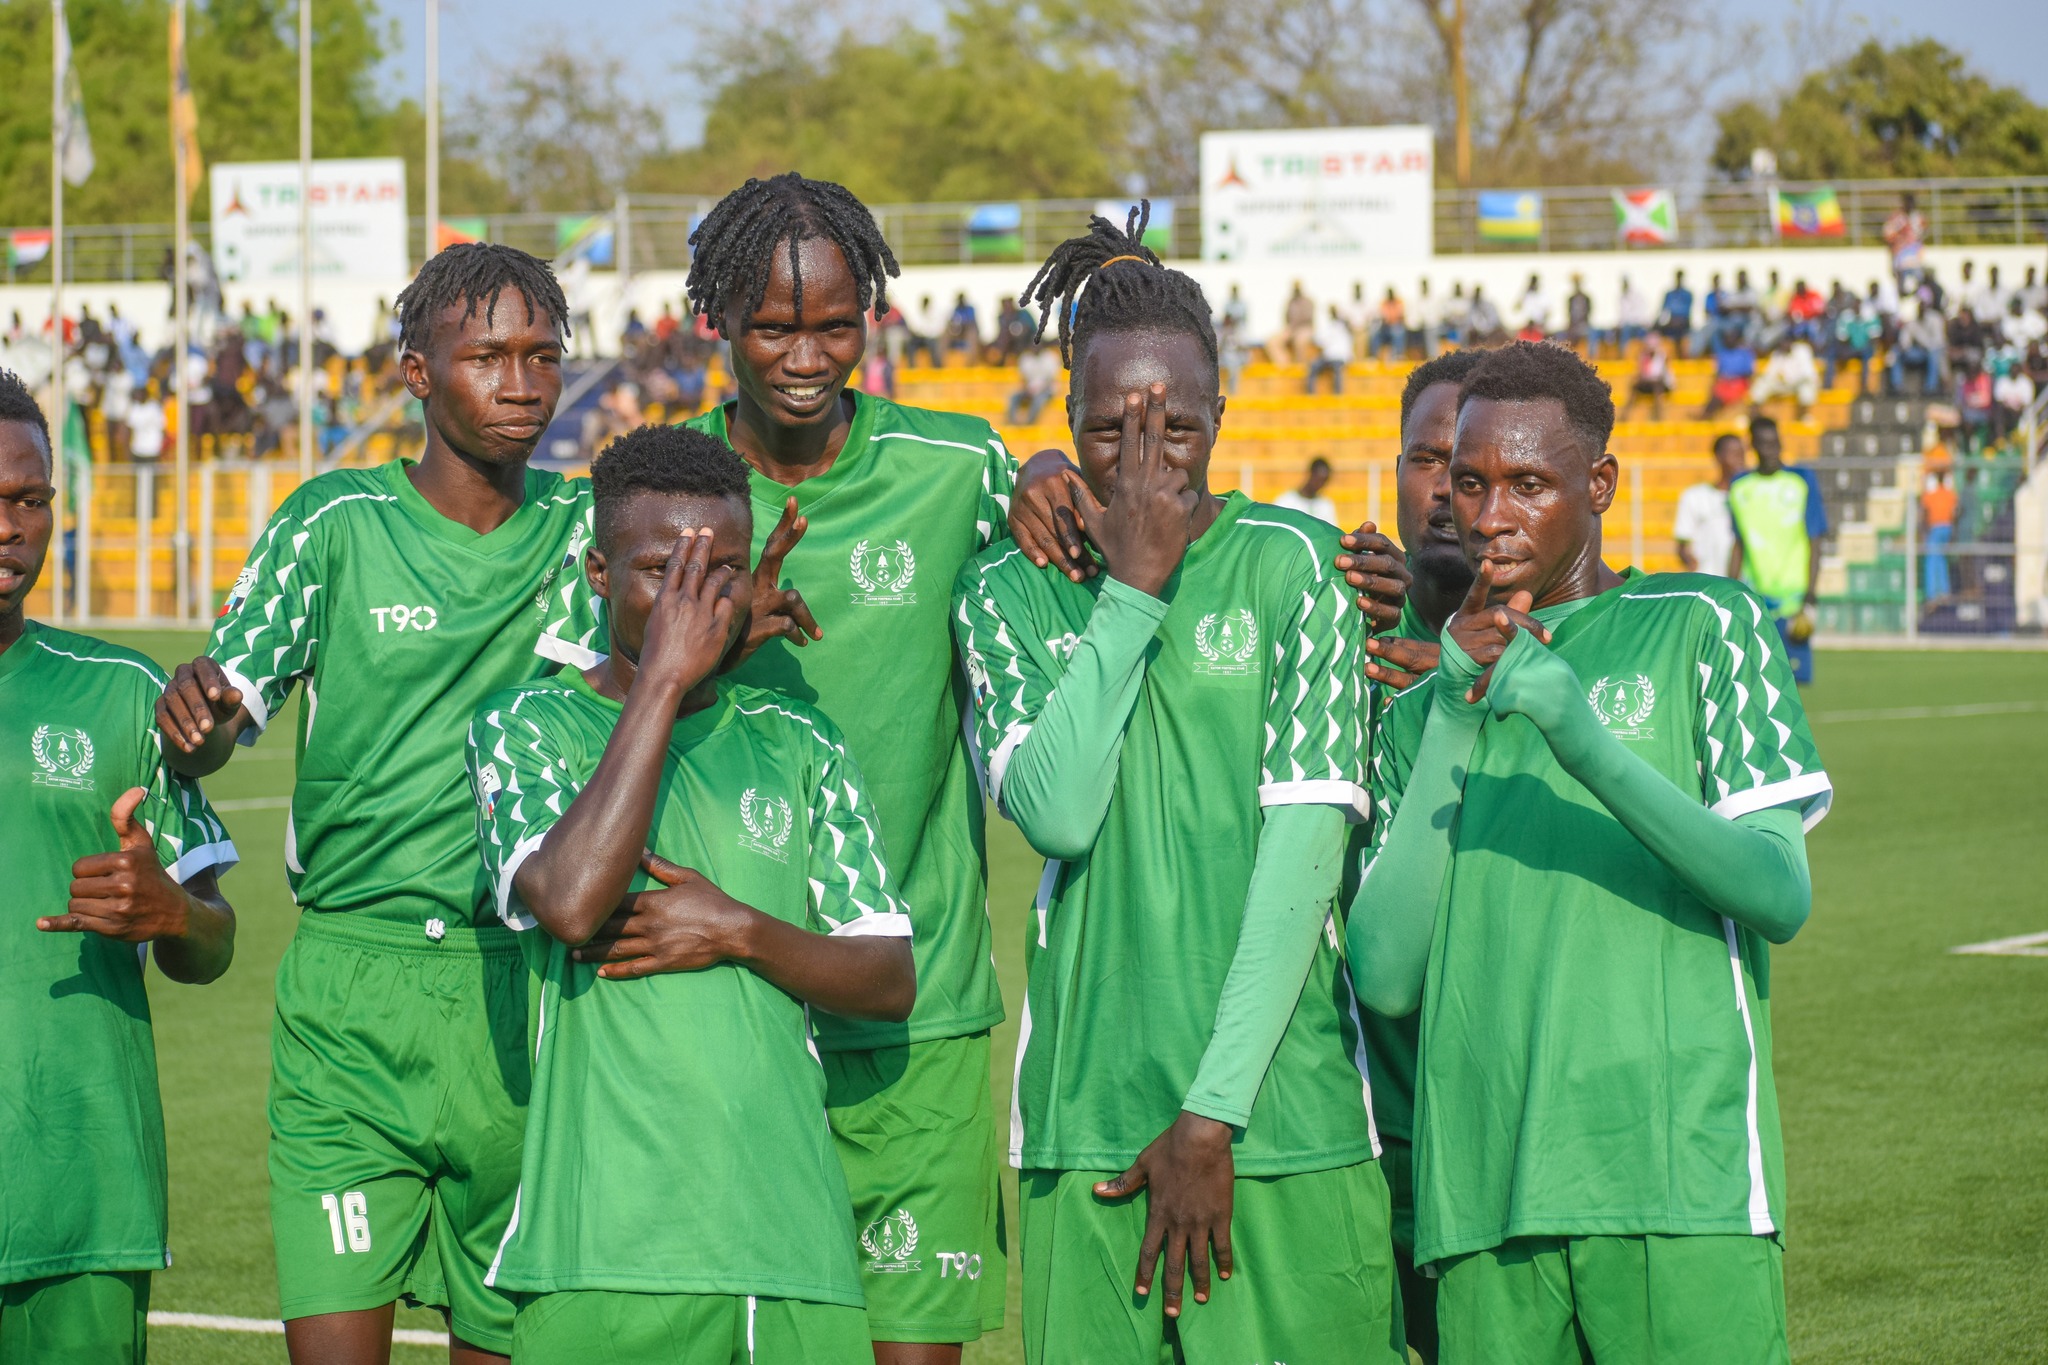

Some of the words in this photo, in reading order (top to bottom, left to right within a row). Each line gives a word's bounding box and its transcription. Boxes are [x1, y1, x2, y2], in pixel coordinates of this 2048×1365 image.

[258, 183, 399, 206] TRSTAR
[370, 604, 438, 632] T90
[1046, 632, 1082, 660] T9
[322, 1192, 371, 1254] 16
